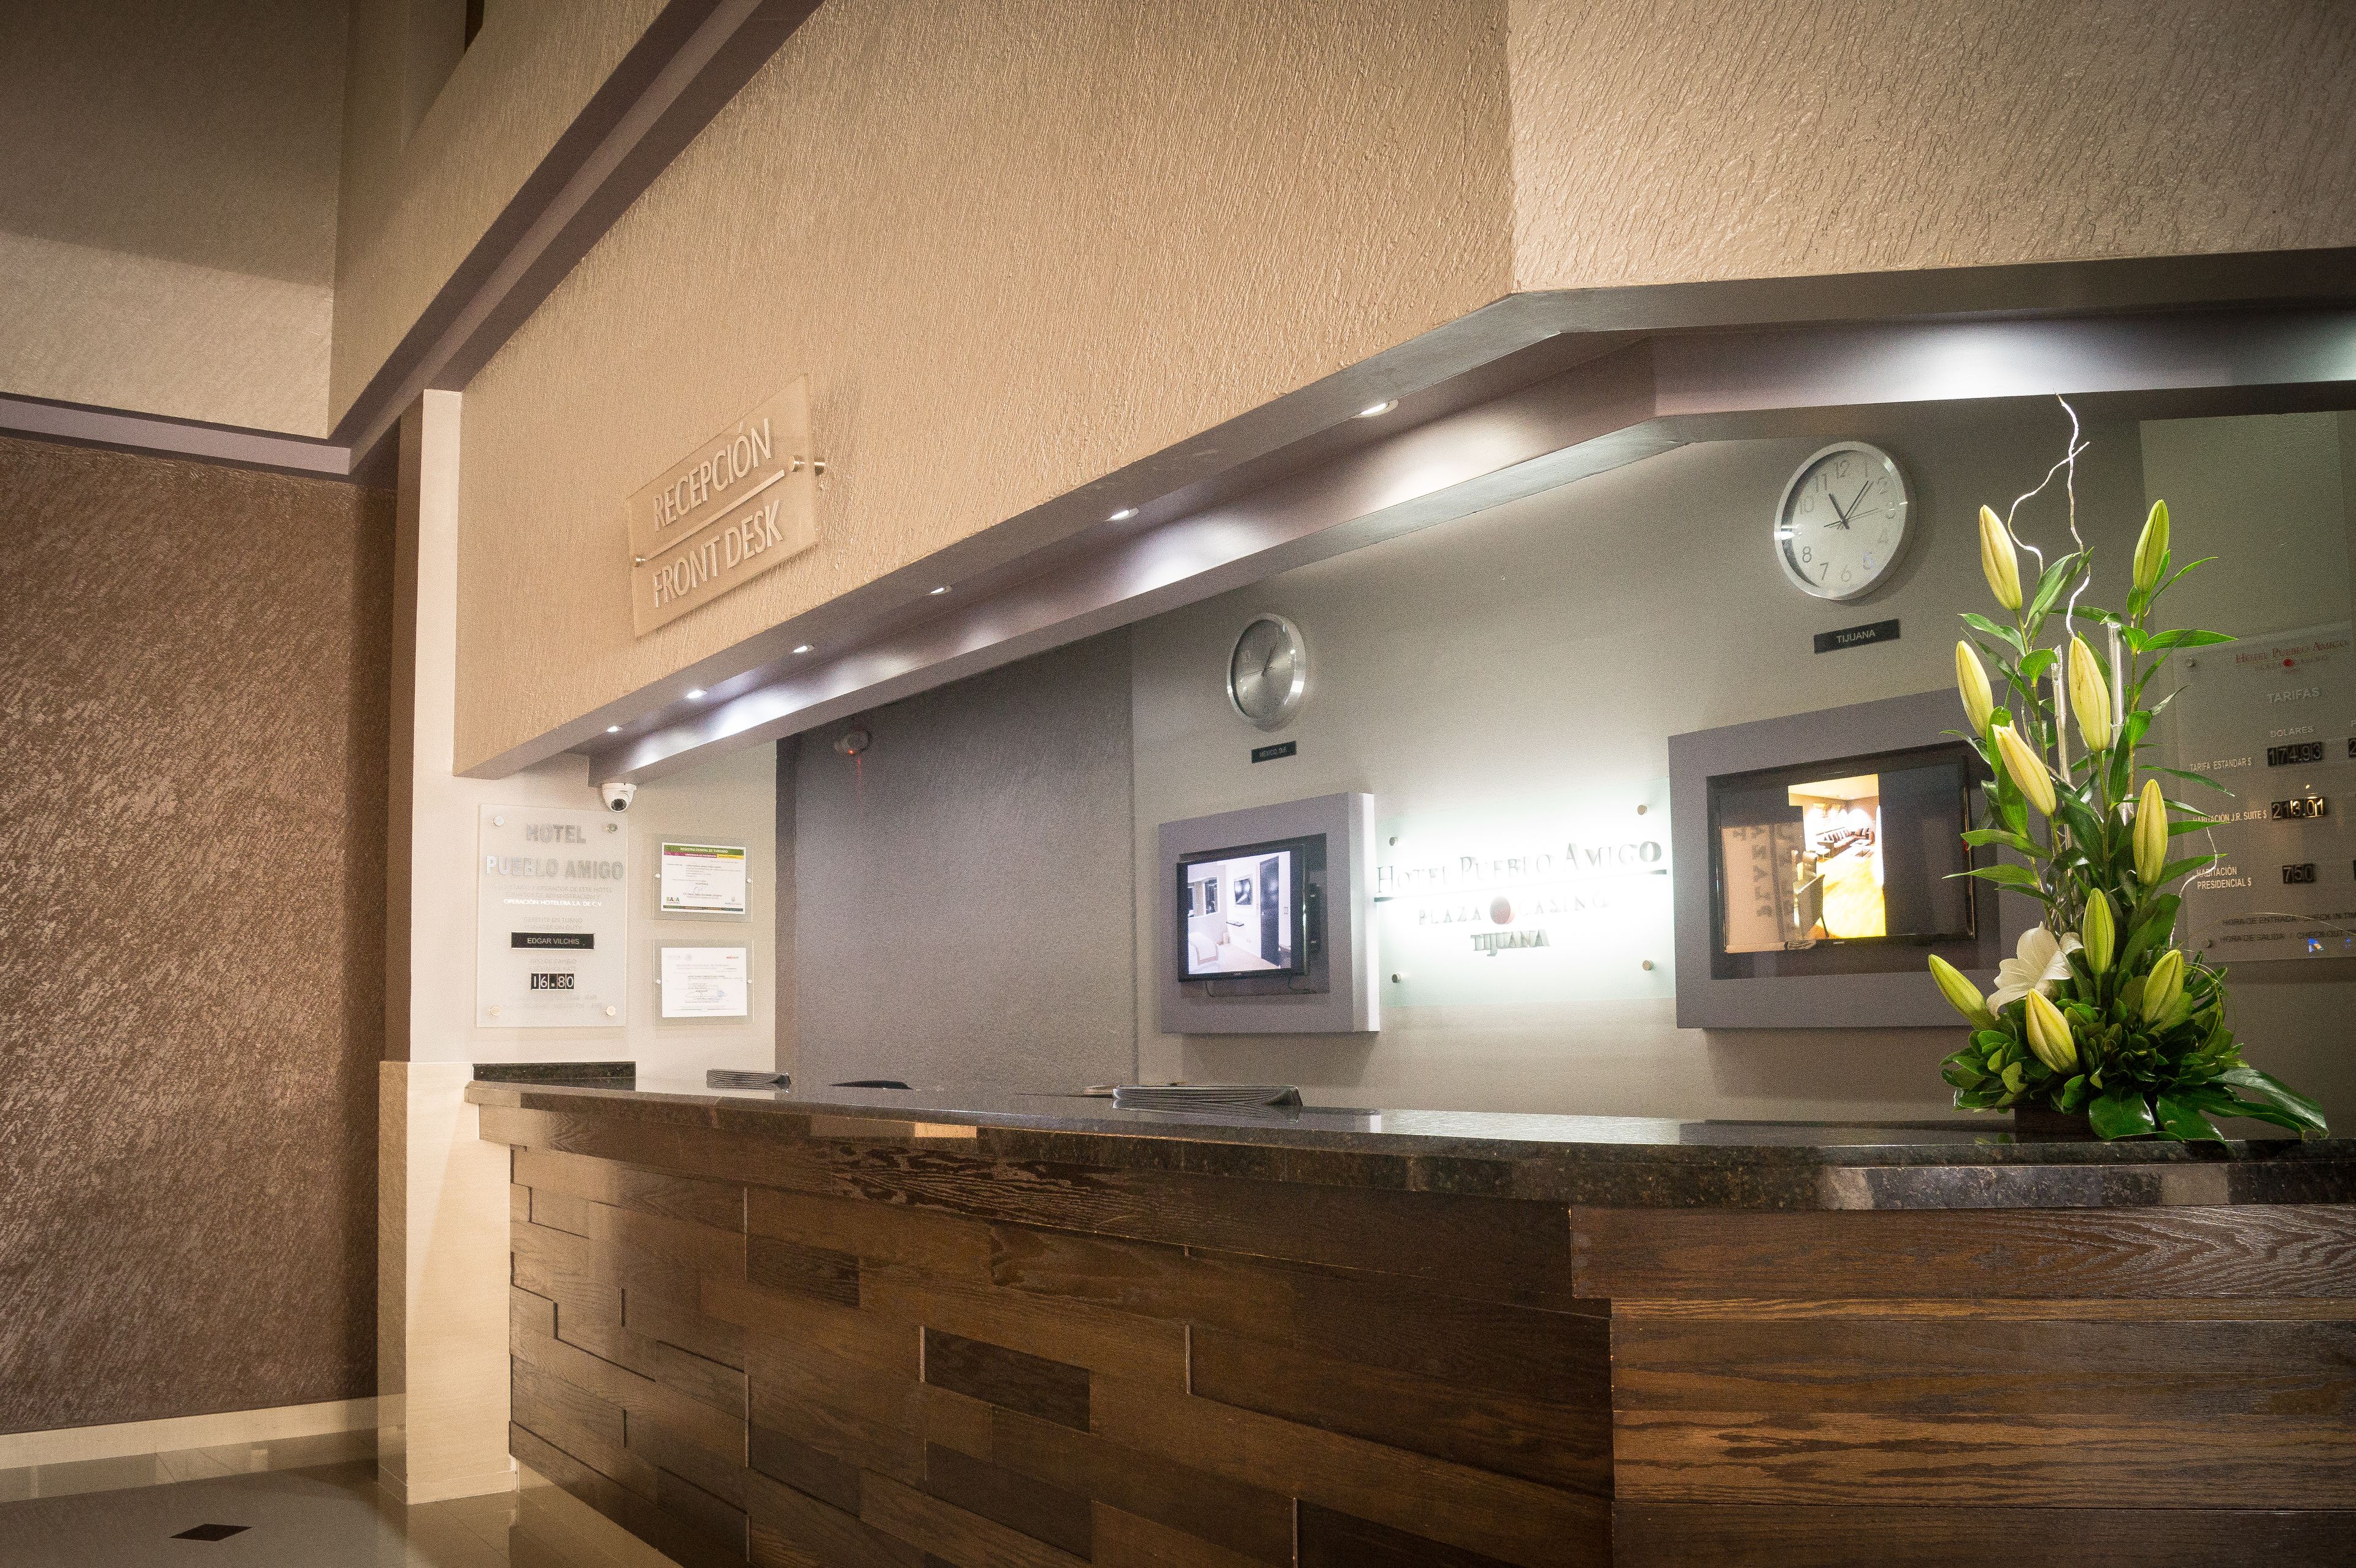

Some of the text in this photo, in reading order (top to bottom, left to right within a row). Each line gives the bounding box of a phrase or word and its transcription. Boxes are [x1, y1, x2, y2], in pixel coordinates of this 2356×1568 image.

[654, 418, 772, 531] RECEPCIÓN
[1834, 459, 1849, 479] 12
[1815, 474, 1828, 493] 11
[654, 499, 783, 608] FRONT DESK
[1802, 546, 1812, 563] 8
[1819, 562, 1830, 580] 7
[1836, 629, 1876, 644] TIJUANA
[2266, 686, 2320, 703] TARIFAS
[2269, 742, 2322, 765] 174.93
[2189, 762, 2210, 772] TARIFA
[2243, 810, 2262, 820] SUITE
[2271, 798, 2324, 820] 213.01
[525, 824, 587, 844] HOTEL
[486, 855, 625, 880] PUEBLO AMIGO
[1377, 867, 1446, 893] HOTEL
[1565, 840, 1661, 871] AMIGO
[2284, 865, 2313, 883] 750
[2197, 877, 2252, 890] PRESIDENCIAL $
[1419, 907, 1482, 926] PLAZA
[1470, 929, 1550, 957] TIJUANA
[532, 975, 574, 988] 16.80
